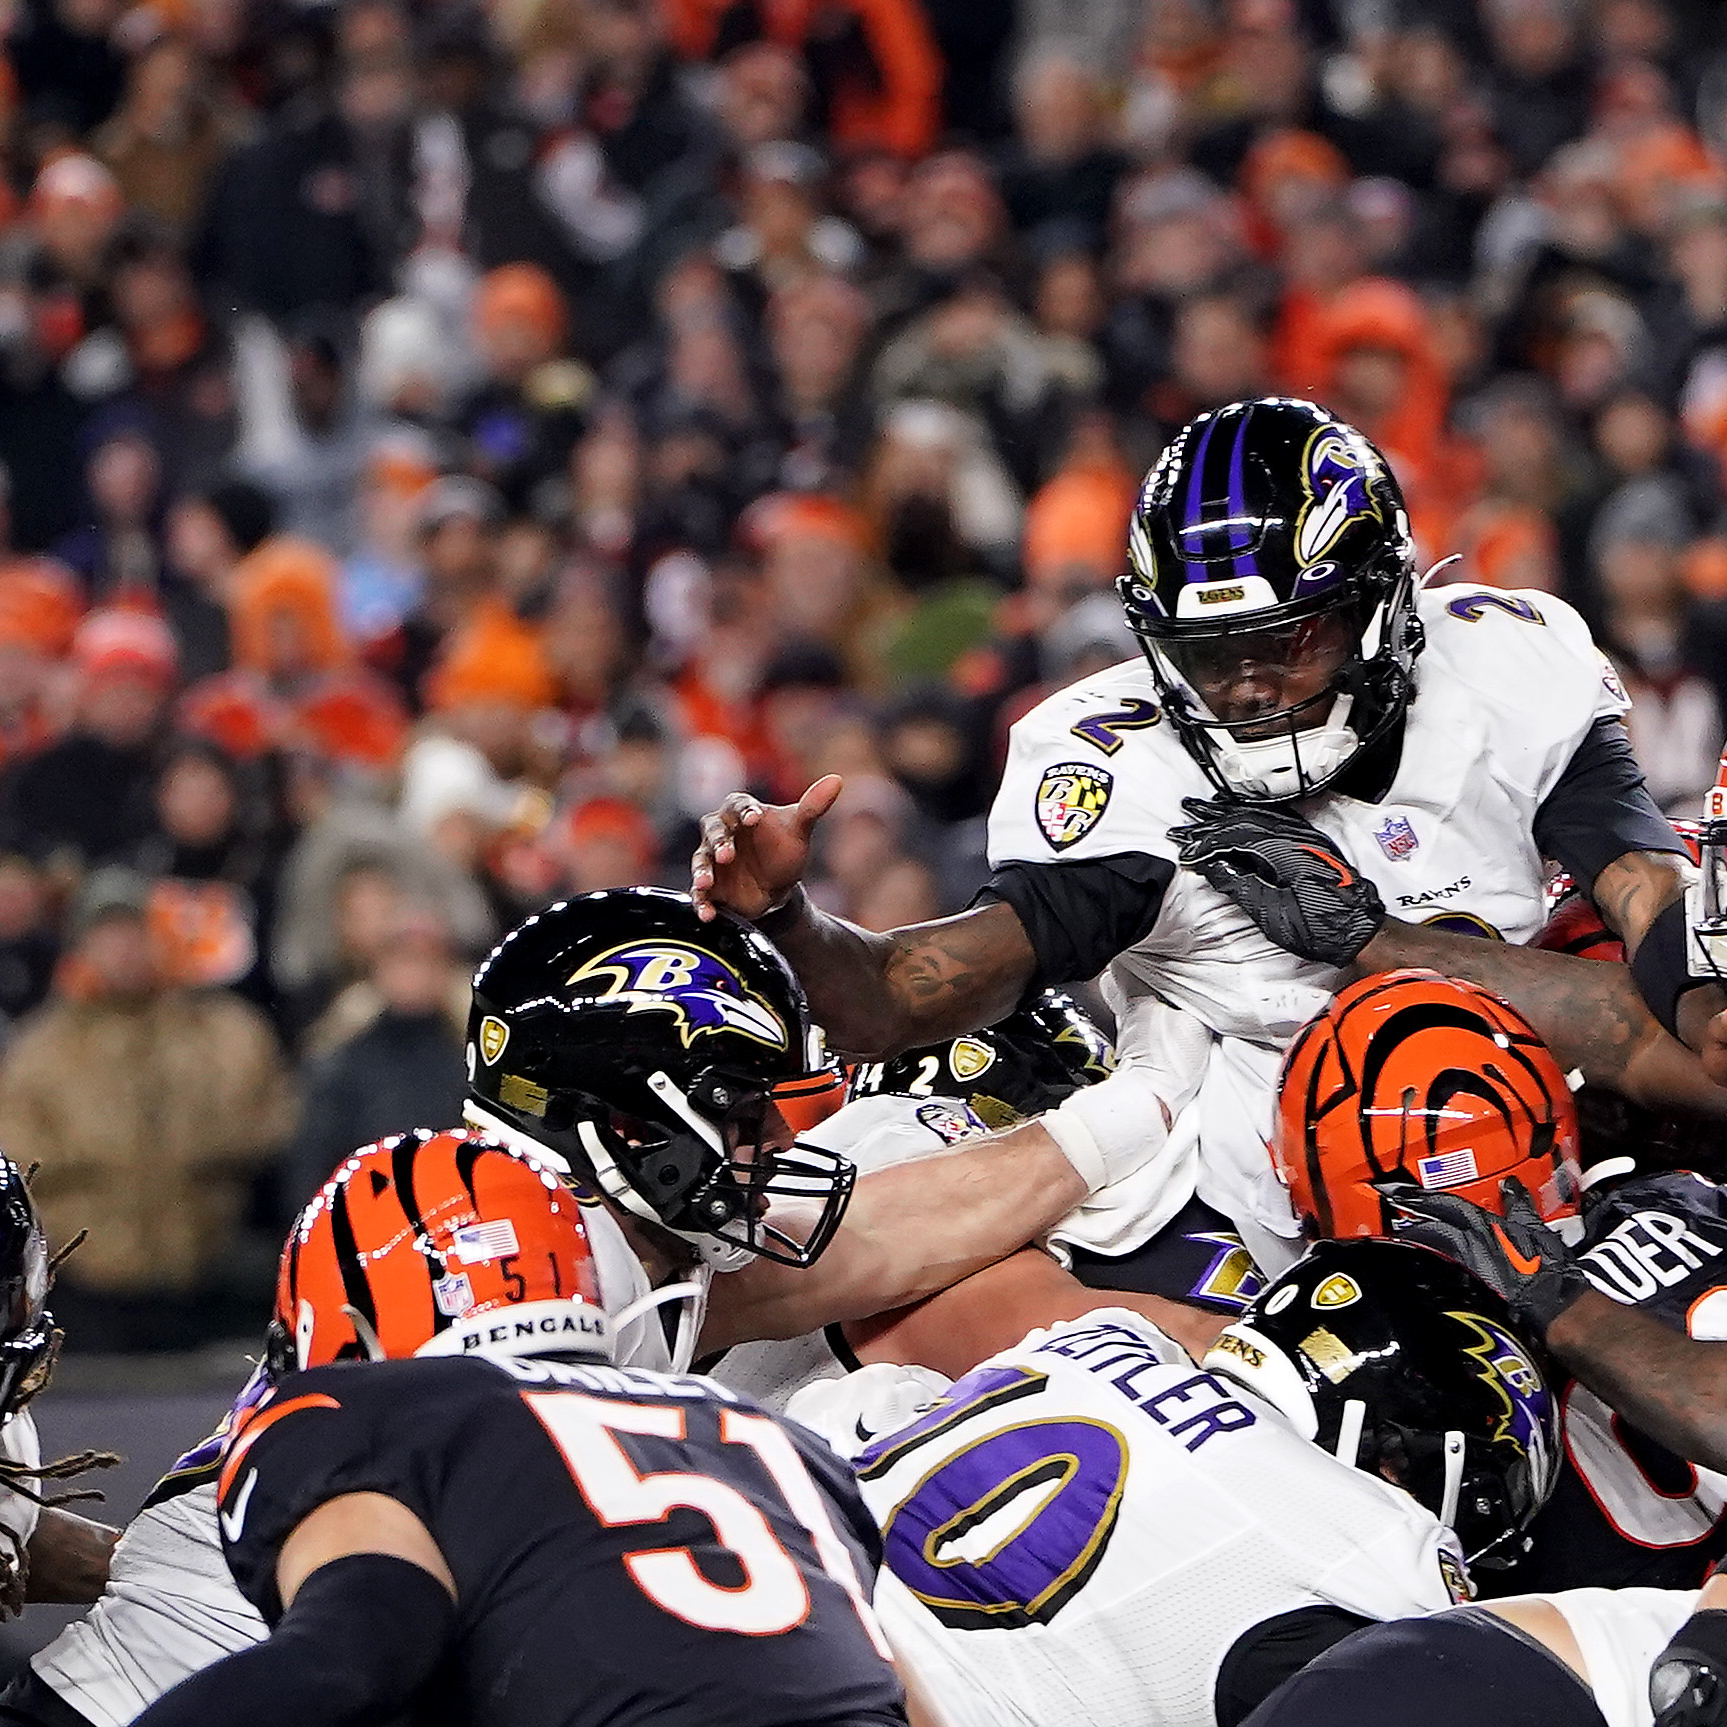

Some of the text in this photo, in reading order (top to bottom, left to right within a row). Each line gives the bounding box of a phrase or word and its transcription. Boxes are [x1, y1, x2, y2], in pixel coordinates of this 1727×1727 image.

[1444, 592, 1547, 627] 2
[1070, 698, 1162, 757] 2
[1045, 763, 1110, 785] RAVENS
[1576, 1210, 1724, 1306] DER
[1221, 1333, 1270, 1369] ENS
[518, 1389, 896, 1662] 51
